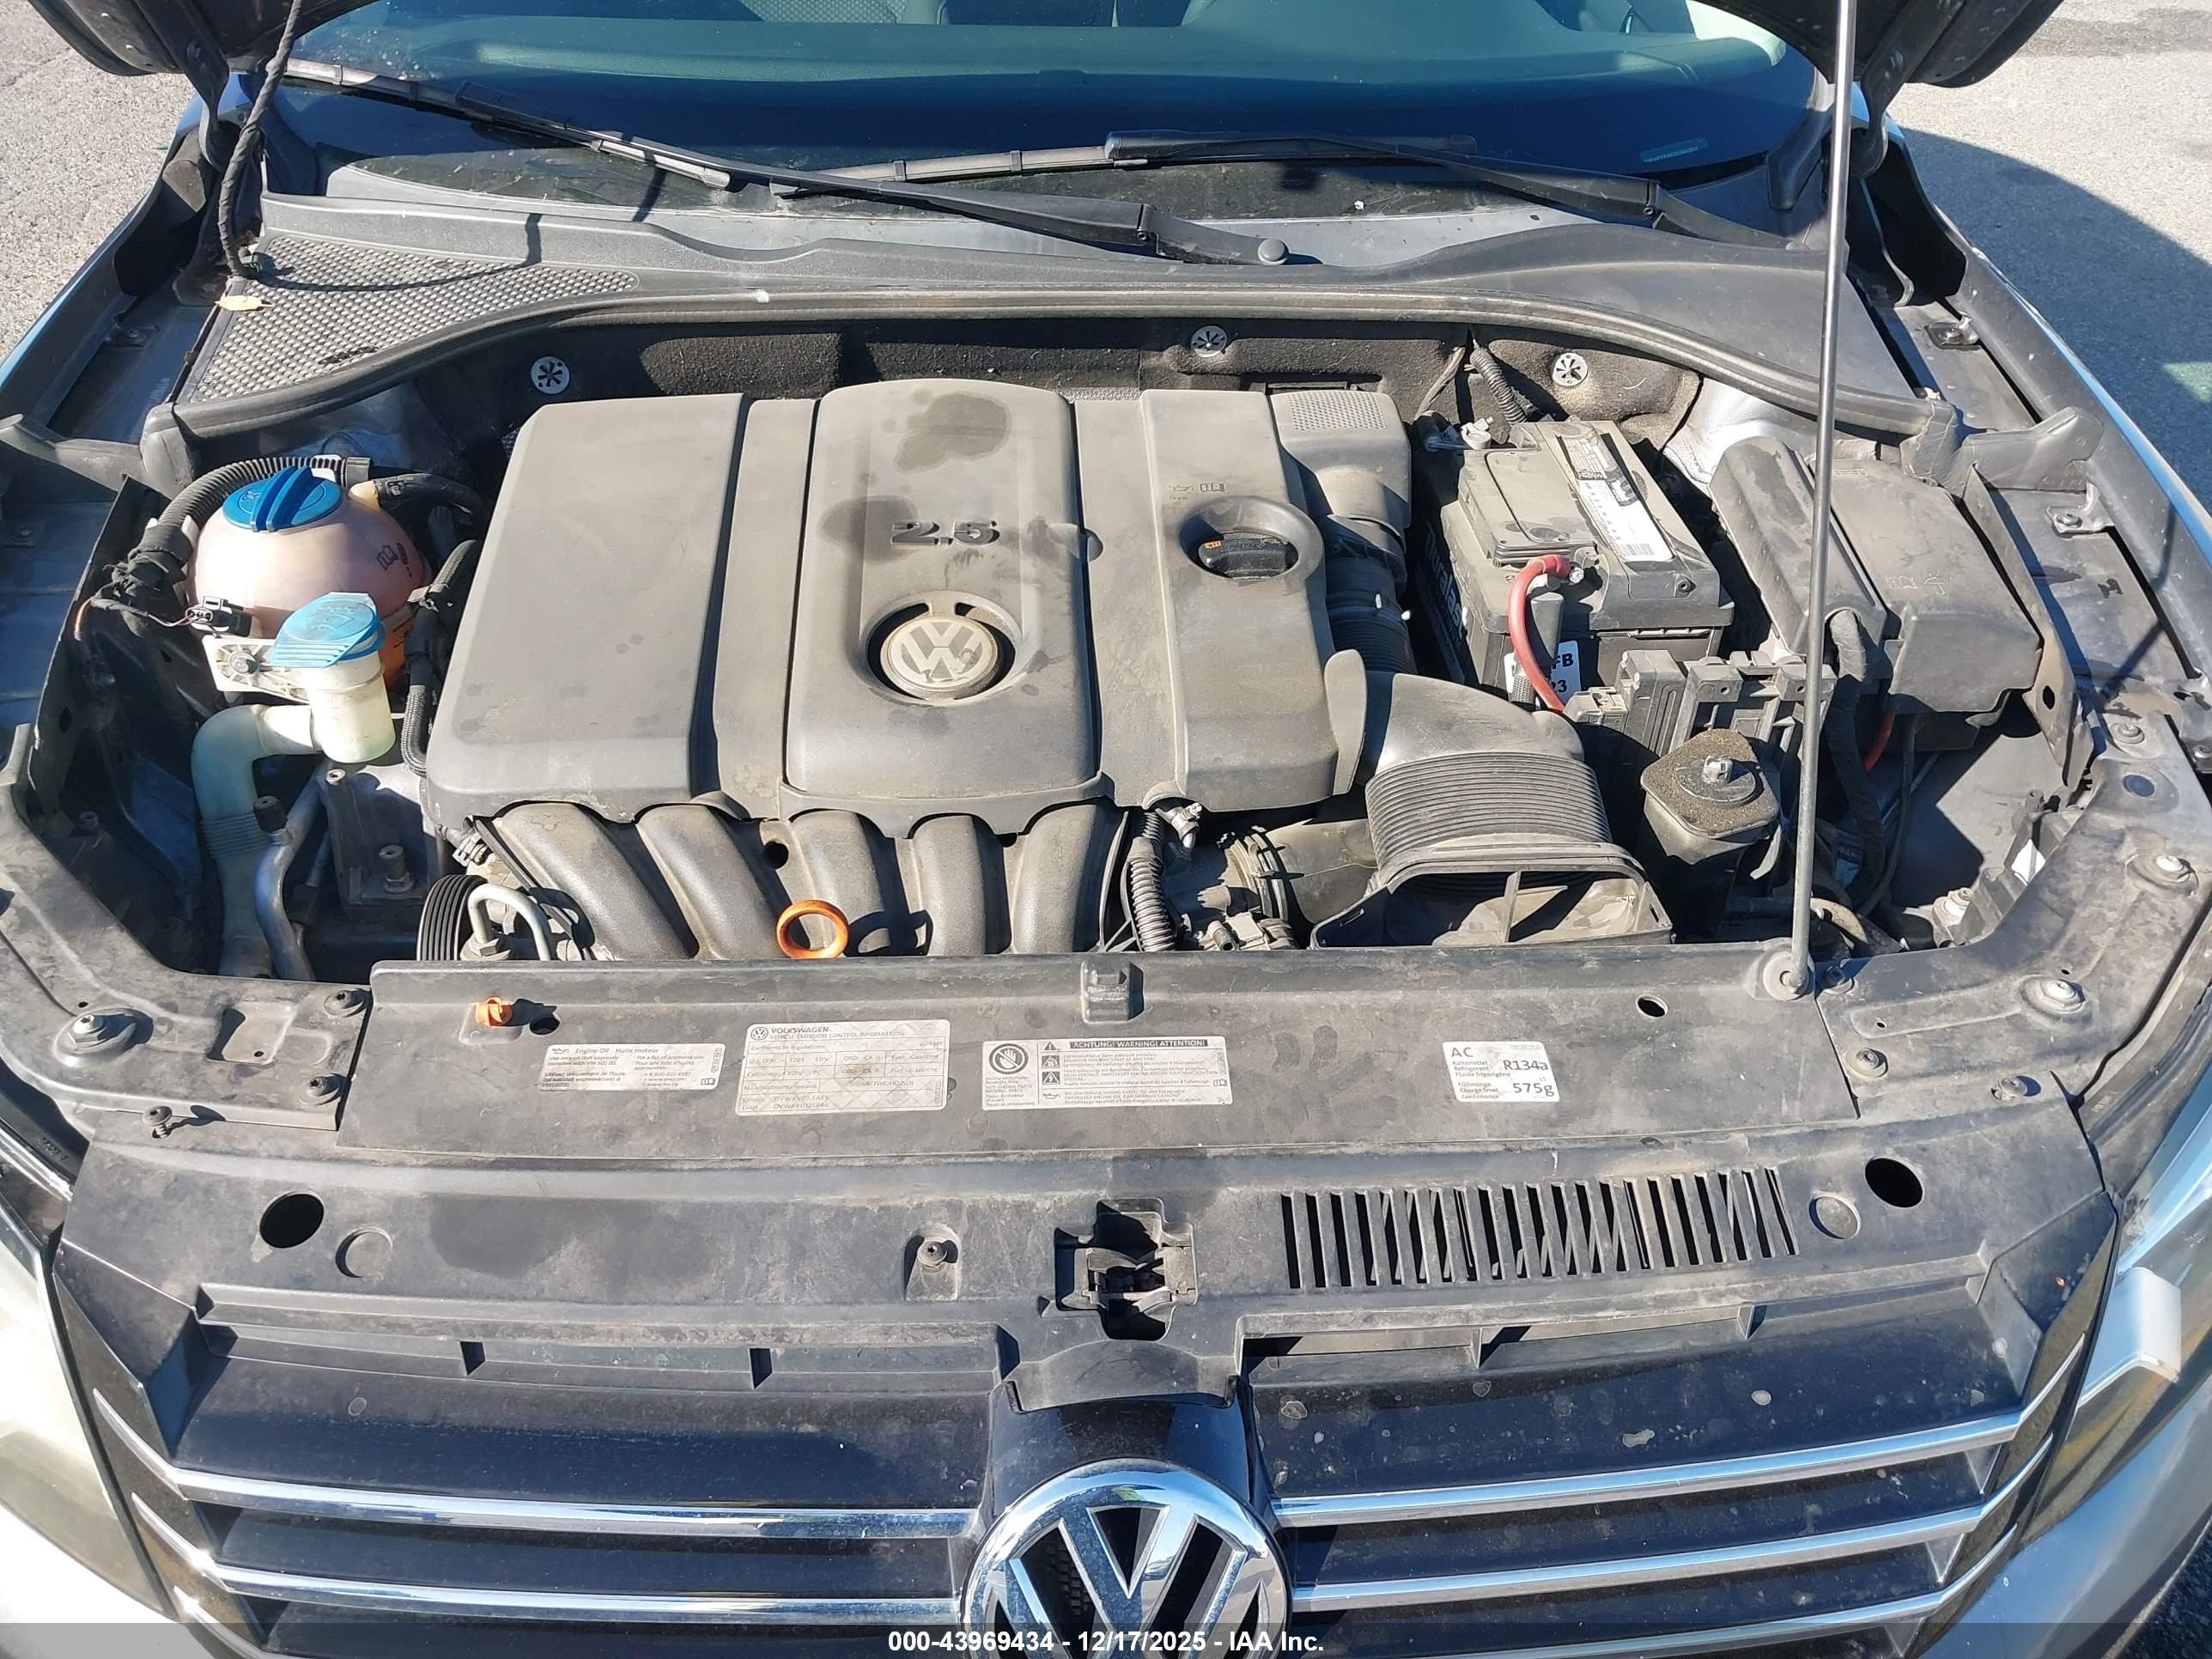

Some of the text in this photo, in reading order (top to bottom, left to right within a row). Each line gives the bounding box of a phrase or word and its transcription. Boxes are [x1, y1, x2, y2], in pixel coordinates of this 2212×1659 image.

[891, 521, 1000, 546] 2.5
[1503, 1060, 1549, 1071] R134a
[1512, 1082, 1555, 1097] 575g
